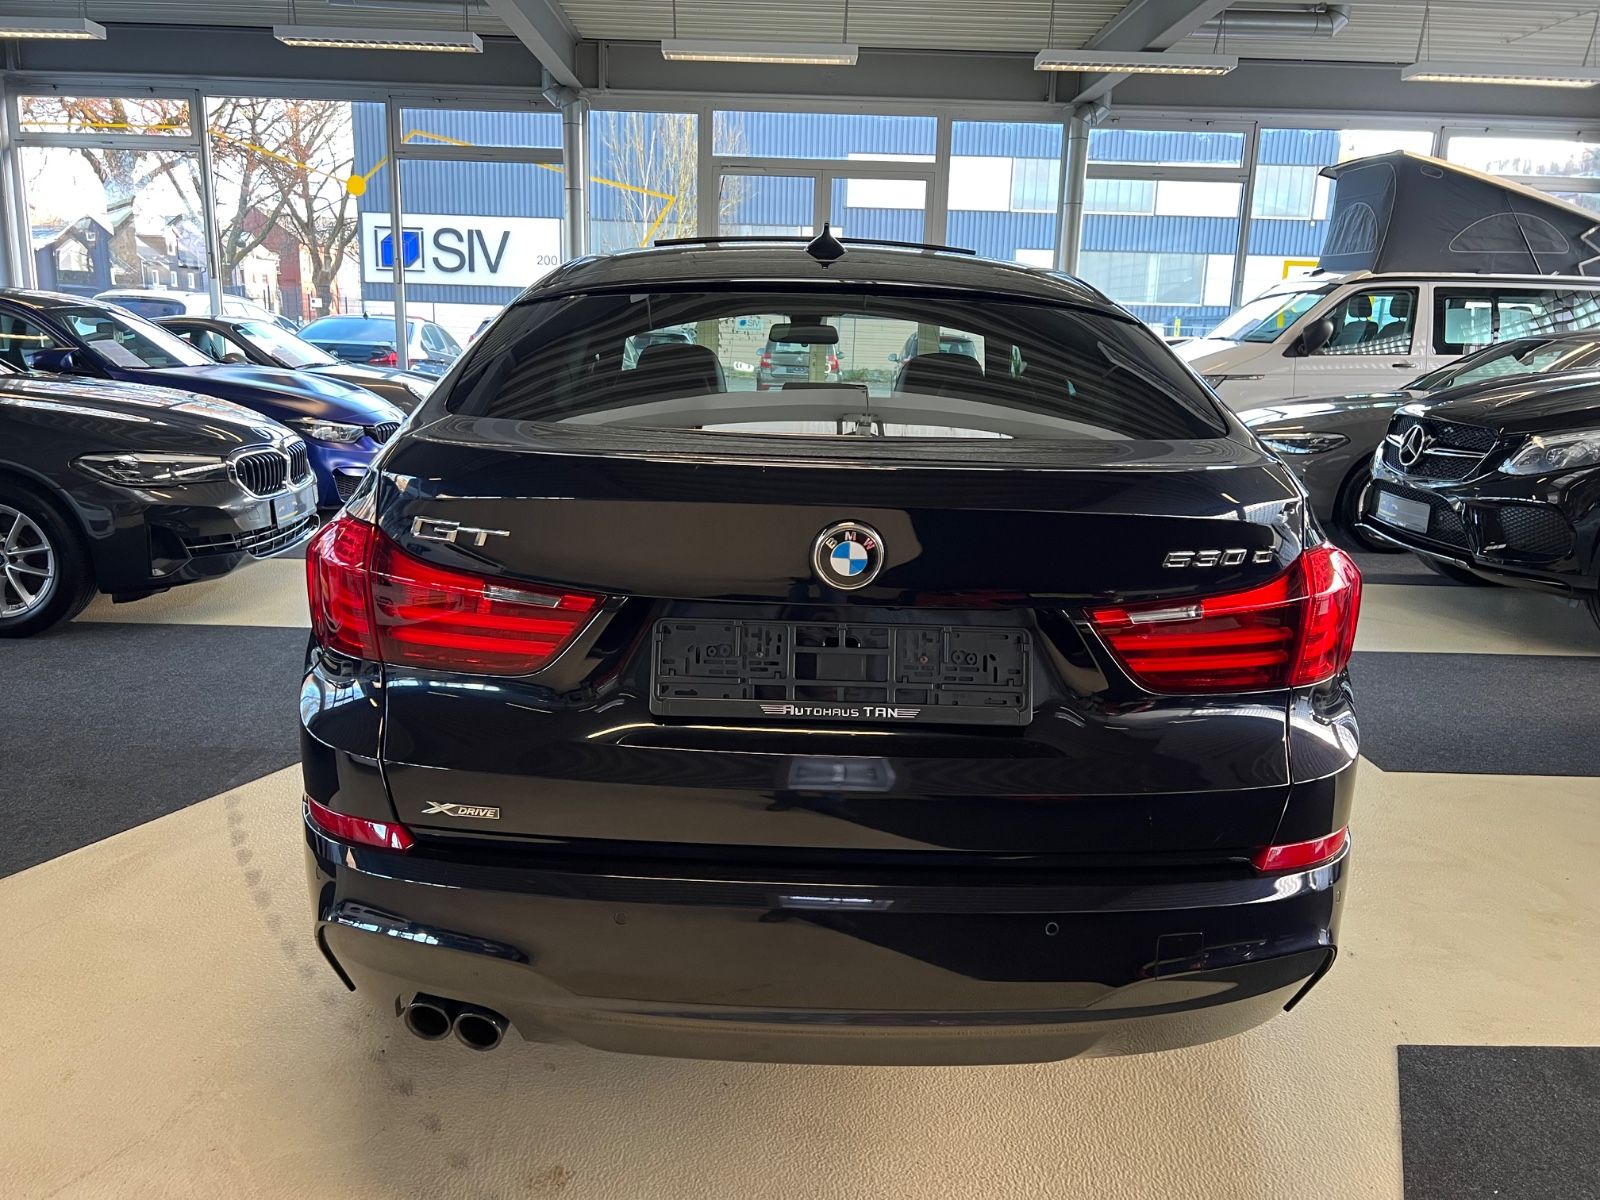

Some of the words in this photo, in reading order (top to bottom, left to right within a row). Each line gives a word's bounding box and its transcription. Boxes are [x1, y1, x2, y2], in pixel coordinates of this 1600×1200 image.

[432, 227, 511, 274] SIV
[536, 254, 558, 266] 200
[410, 515, 511, 547] GT
[825, 531, 875, 550] BMW
[1162, 549, 1248, 568] 530
[1252, 545, 1276, 564] d
[782, 704, 859, 718] AUTOHAUS
[863, 706, 897, 718] TAN
